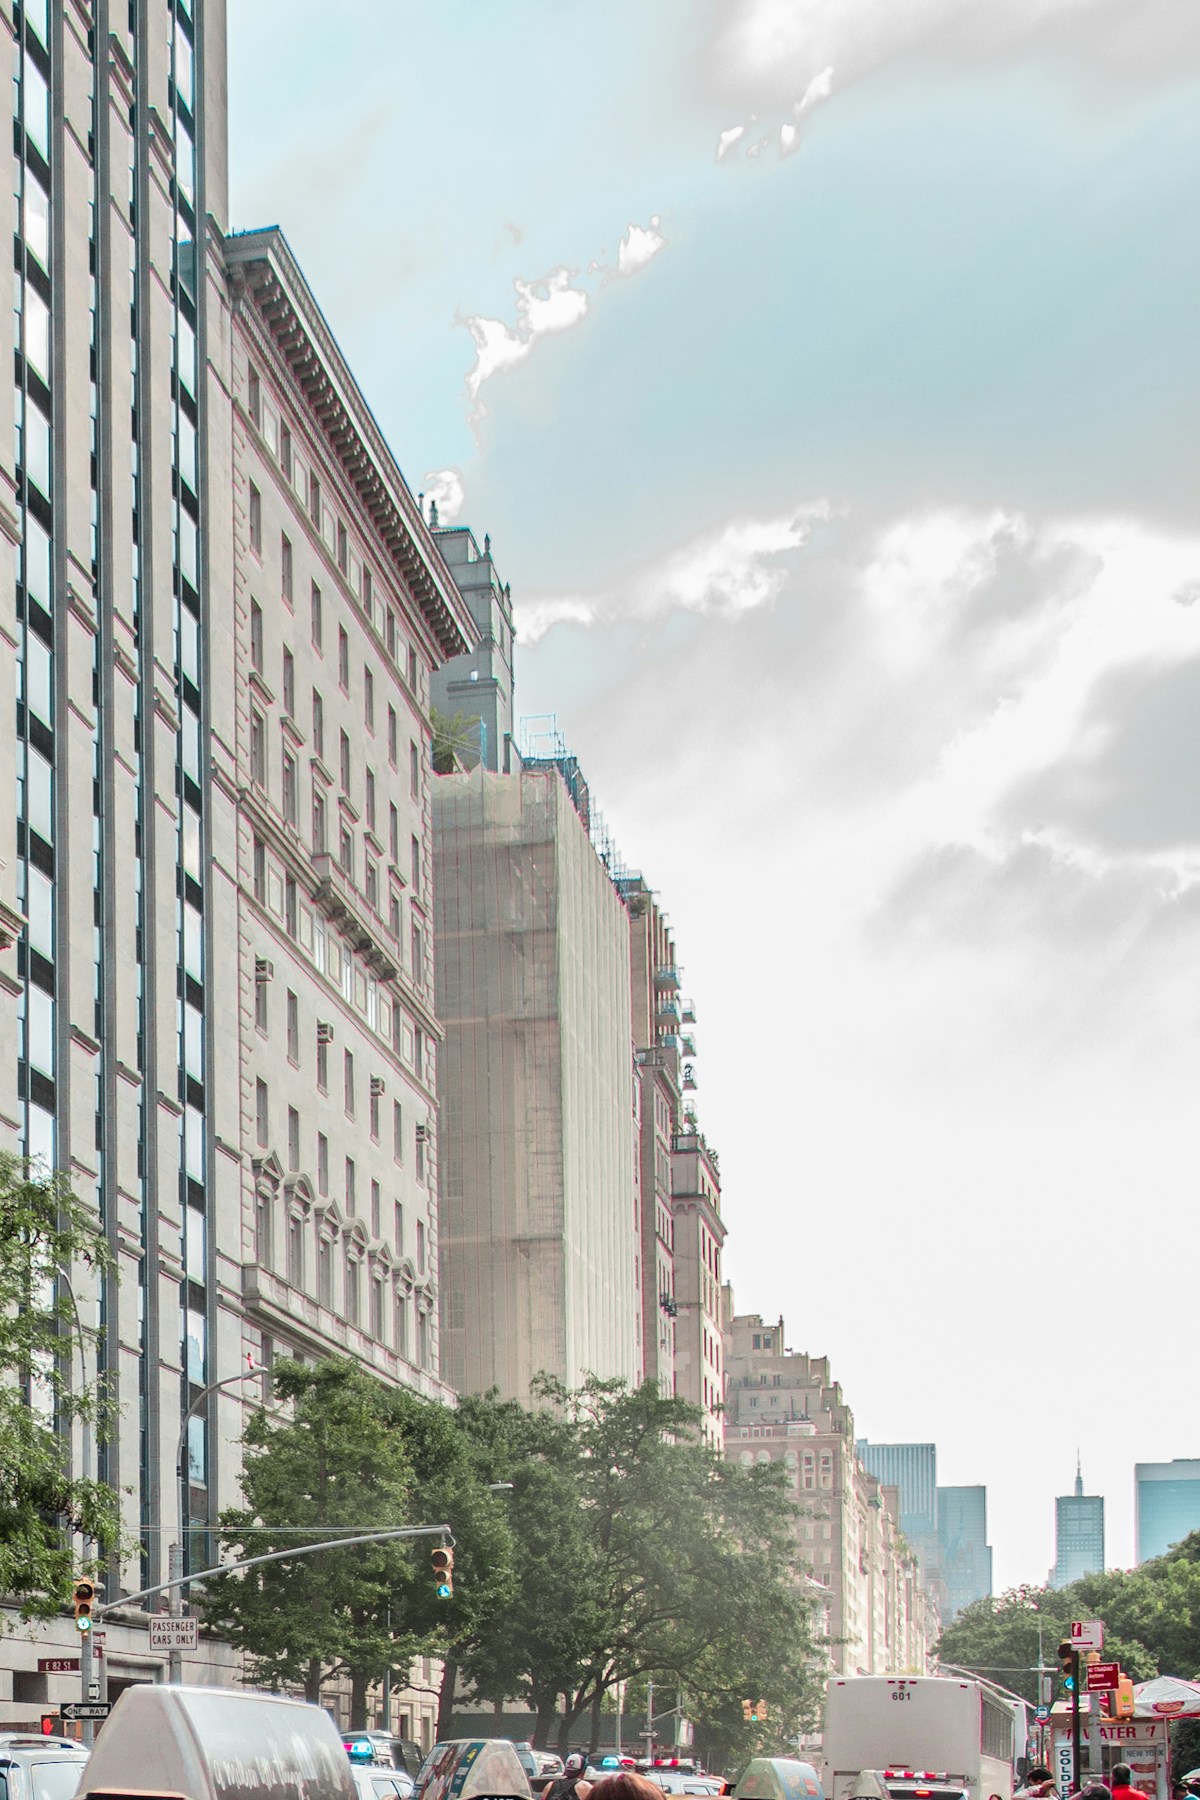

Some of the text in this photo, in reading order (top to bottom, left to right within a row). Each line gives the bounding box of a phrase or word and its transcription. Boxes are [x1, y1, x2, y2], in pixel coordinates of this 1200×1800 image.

[152, 1621, 195, 1632] PASSENGER
[152, 1634, 195, 1645] CARS ONLY
[45, 1662, 50, 1671] E
[52, 1661, 61, 1671] 82
[892, 1691, 911, 1701] 601
[67, 1706, 105, 1715] ONE WAY
[1059, 1749, 1071, 1782] COLD
